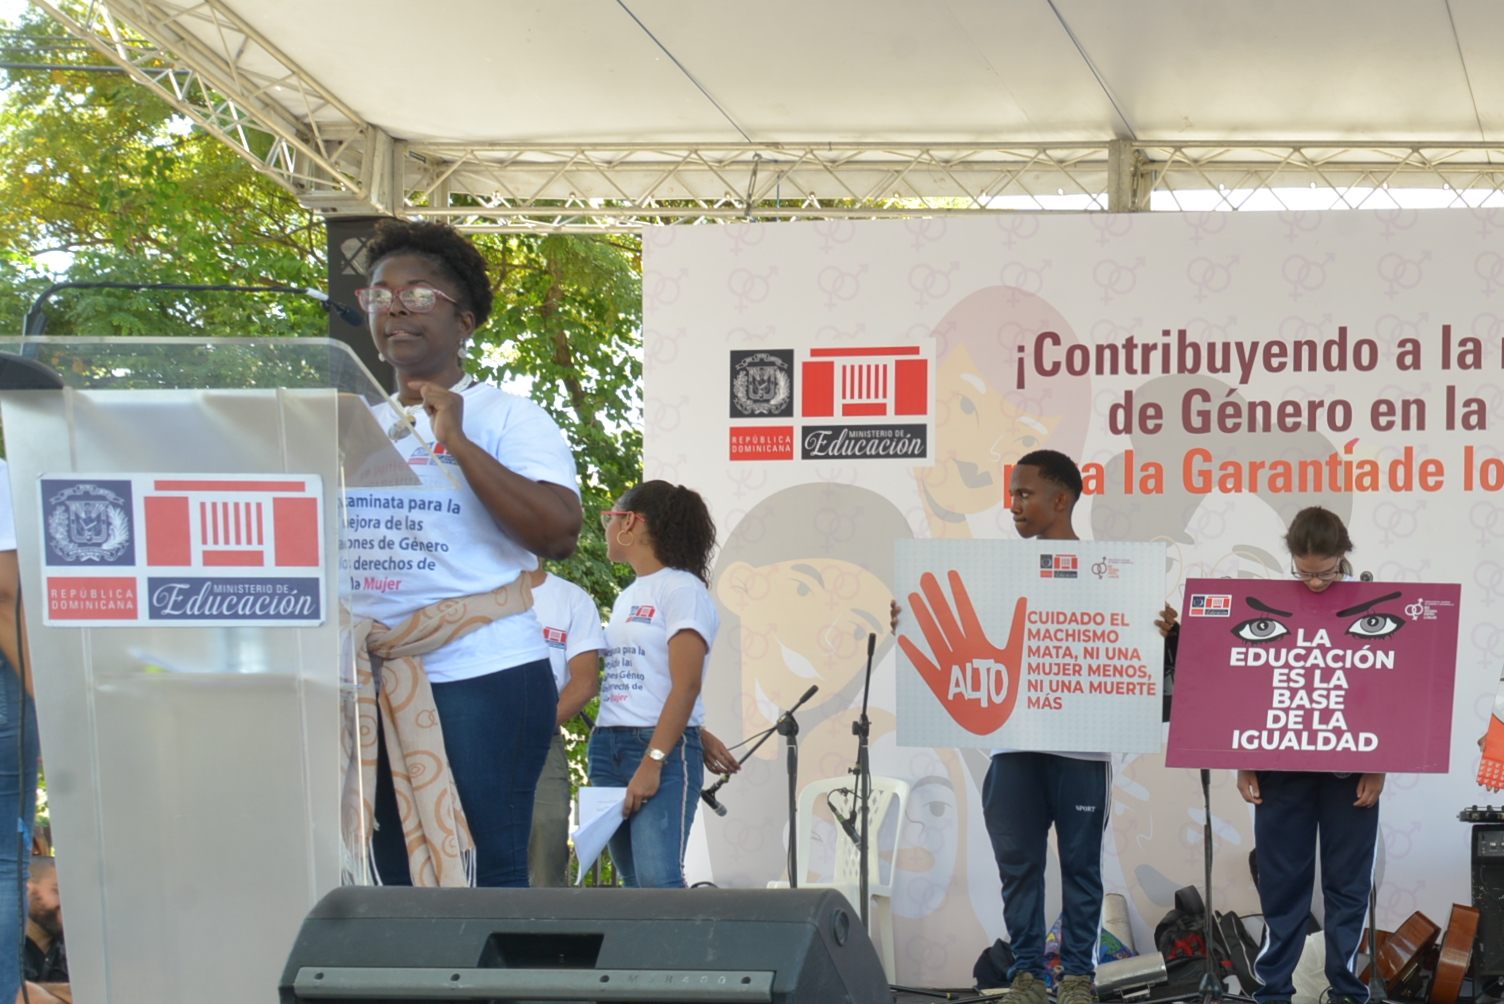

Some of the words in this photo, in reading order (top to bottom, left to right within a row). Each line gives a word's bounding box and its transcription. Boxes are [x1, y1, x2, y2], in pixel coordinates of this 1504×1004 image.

[1016, 326, 1379, 389] ¡Contribuyendo
[1396, 337, 1421, 370] a
[1441, 324, 1483, 370] la
[1108, 390, 1163, 435] de
[1181, 387, 1353, 434] Género
[1370, 397, 1426, 432] en
[1446, 385, 1487, 431] la
[732, 434, 791, 444] REPÚBLICA
[804, 428, 924, 456] Educación
[849, 430, 893, 438] MINISTERIO
[895, 429, 905, 437] DE
[732, 444, 791, 453] DOMINICANA
[1124, 449, 1163, 494] la
[408, 498, 442, 513] para
[447, 498, 461, 514] la
[385, 515, 402, 530] de
[405, 515, 423, 531] las
[378, 535, 395, 550] de
[399, 537, 449, 552] Género
[353, 555, 413, 571] derechos
[417, 557, 436, 571] de
[51, 586, 134, 599] REPÚBLICA
[213, 584, 273, 594] MINISTERIO
[276, 584, 289, 593] DE
[350, 576, 360, 590] la
[363, 577, 402, 593] Mujer
[51, 600, 134, 610] DOMINICANA
[152, 581, 316, 616] Educación
[1027, 611, 1105, 626] CUIDADO
[1110, 613, 1130, 627] EL
[1027, 628, 1119, 644] MACHISMO
[1297, 629, 1332, 647] LA
[1027, 645, 1079, 662] MATA,
[1083, 646, 1100, 660] NI
[1105, 647, 1142, 661] UNA
[1230, 645, 1395, 670] EDUCACIÓN
[1027, 662, 1082, 677] MUJER
[1087, 663, 1152, 681] MENOS,
[1272, 668, 1306, 688] ES
[1313, 669, 1348, 689] LA
[948, 659, 1008, 708] ALTO
[1027, 679, 1044, 693] NI
[1048, 680, 1084, 694] UNA
[1089, 681, 1157, 696] MUERTE
[1027, 693, 1063, 710] MÁS
[1272, 689, 1346, 709] BASE
[1266, 710, 1304, 729] DE
[1312, 711, 1348, 730] LA
[1232, 730, 1379, 752] IGUALDAD
